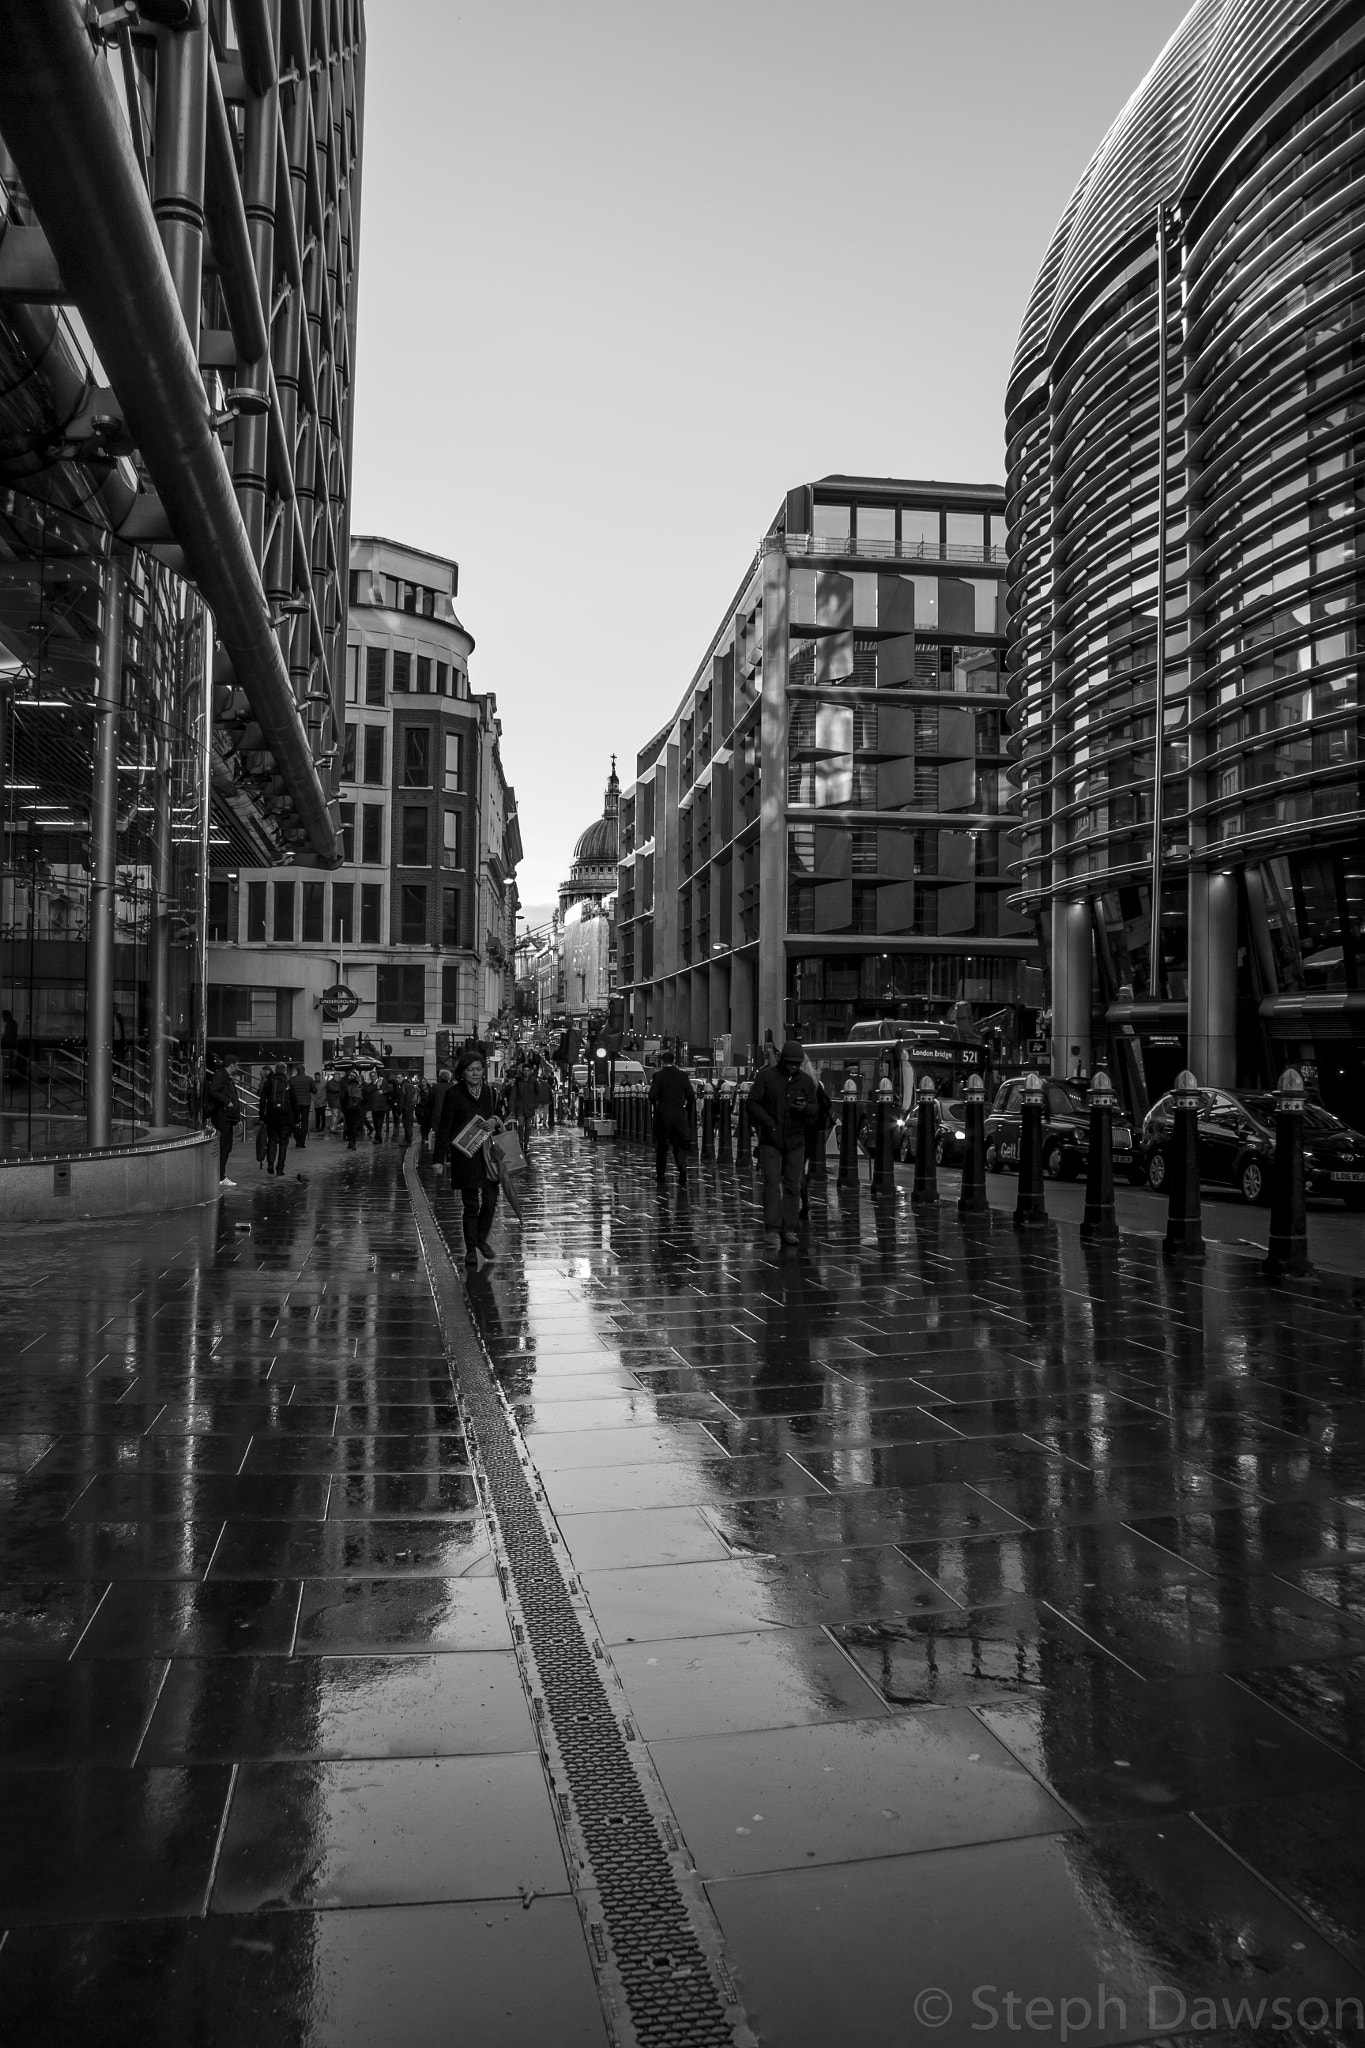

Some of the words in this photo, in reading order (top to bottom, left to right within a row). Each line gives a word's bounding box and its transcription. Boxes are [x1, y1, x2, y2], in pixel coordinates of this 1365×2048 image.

[912, 1049, 933, 1057] London
[935, 1050, 952, 1060] Bridge
[962, 1051, 978, 1063] 521
